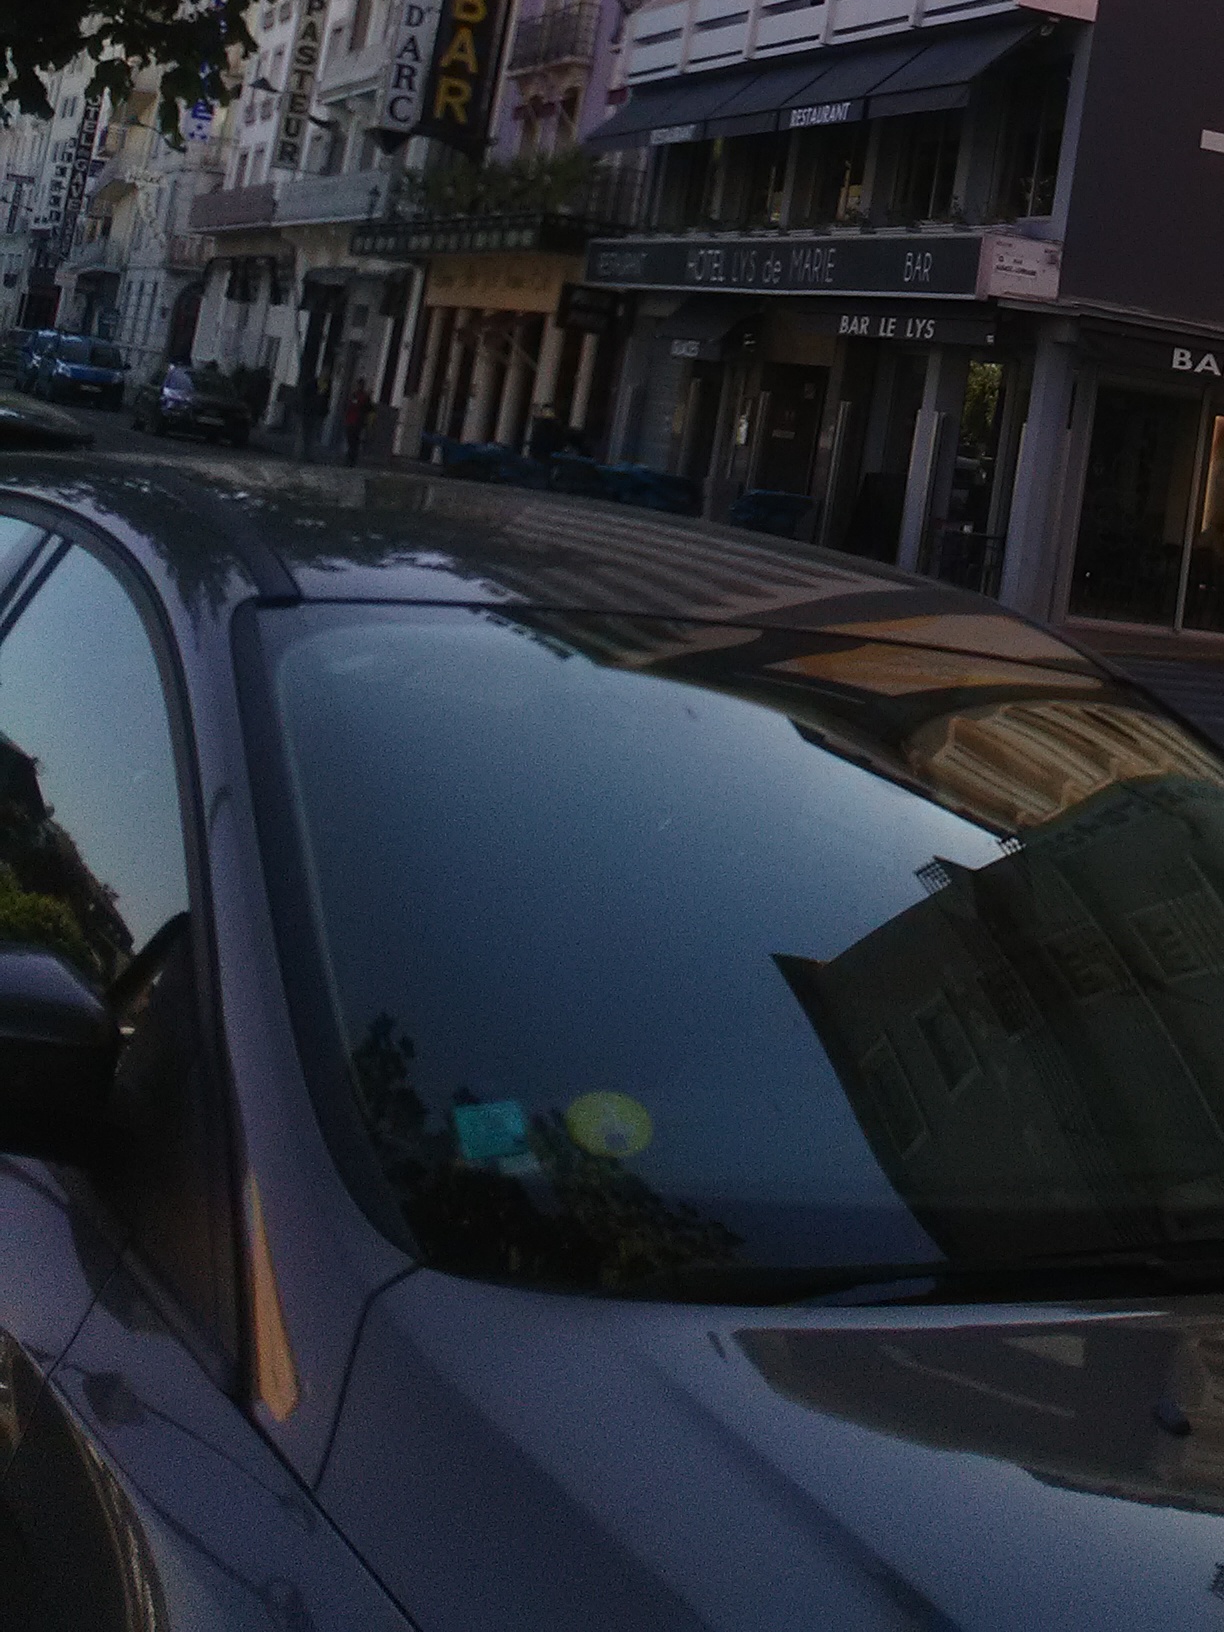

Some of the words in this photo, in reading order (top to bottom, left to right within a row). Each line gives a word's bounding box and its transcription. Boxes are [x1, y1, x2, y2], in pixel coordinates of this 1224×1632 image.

[788, 101, 851, 128] RESTAURANT
[730, 249, 758, 282] LYS
[762, 252, 782, 284] de
[788, 247, 837, 283] MARIE
[903, 251, 933, 282] BAR
[838, 314, 870, 335] BAR
[878, 316, 897, 337] LE
[905, 318, 936, 339] LYS
